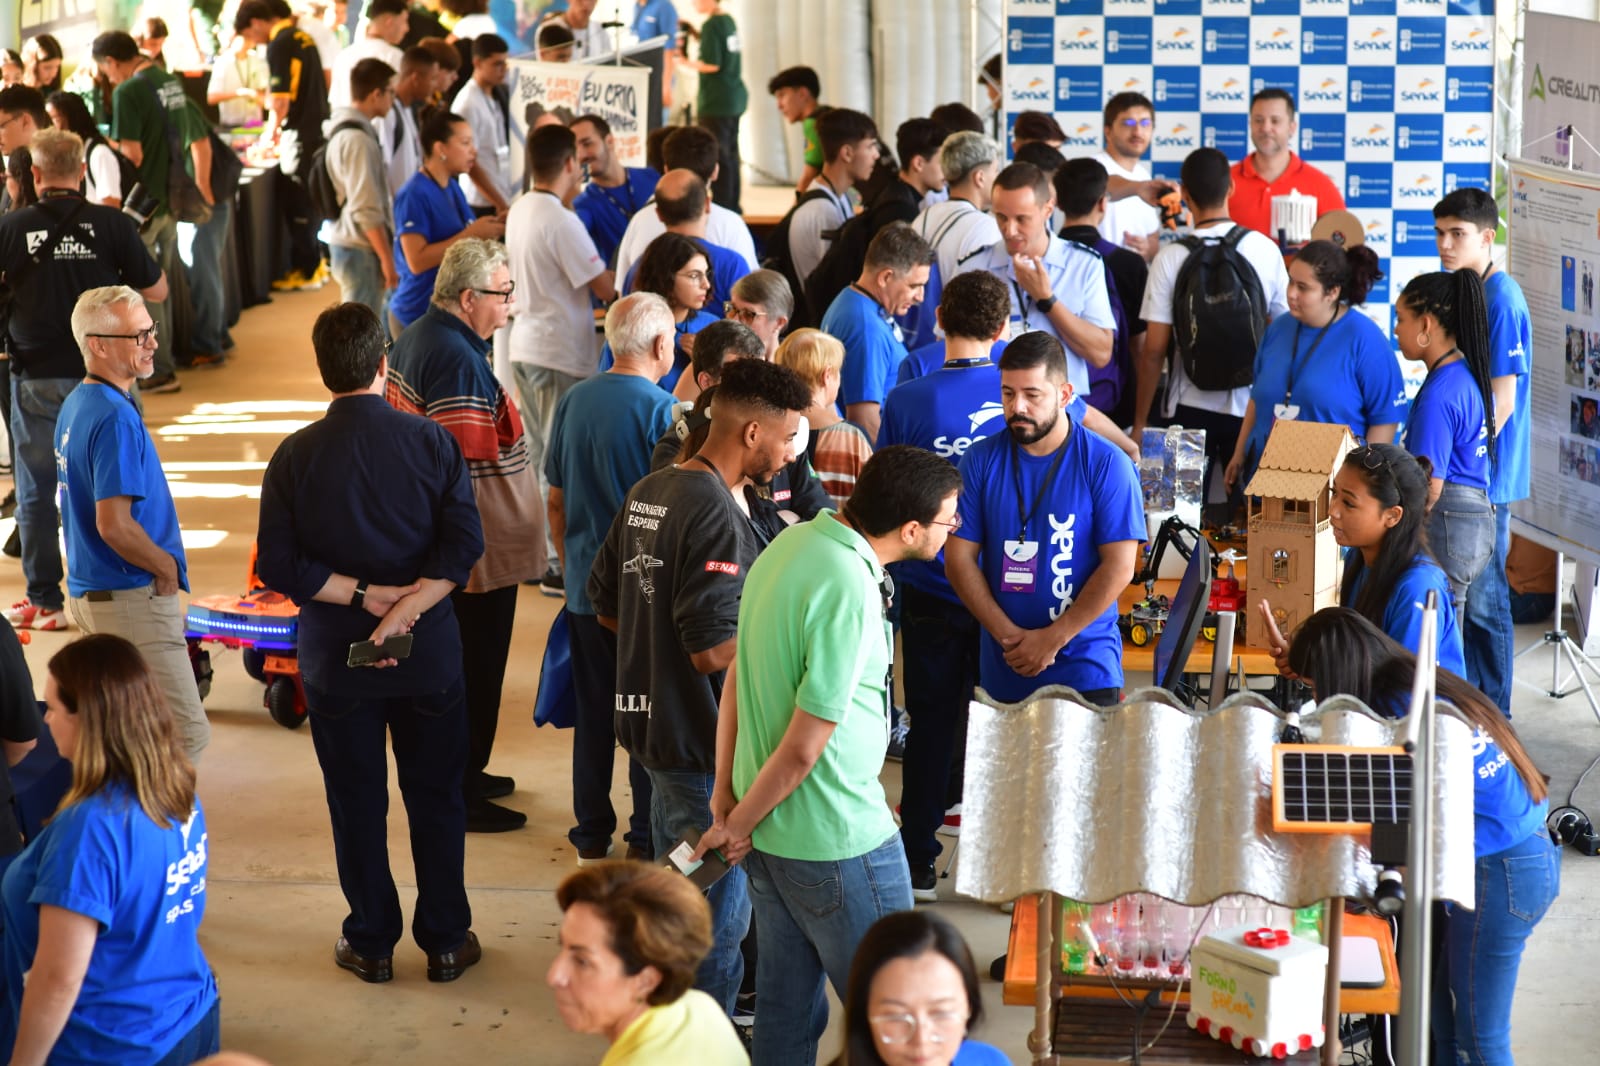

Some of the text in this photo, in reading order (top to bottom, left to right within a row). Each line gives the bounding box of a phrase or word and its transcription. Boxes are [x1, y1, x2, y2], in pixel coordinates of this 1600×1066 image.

[1548, 76, 1600, 104] CREALIT
[708, 560, 738, 575] SENAI
[1048, 513, 1075, 622] senac
